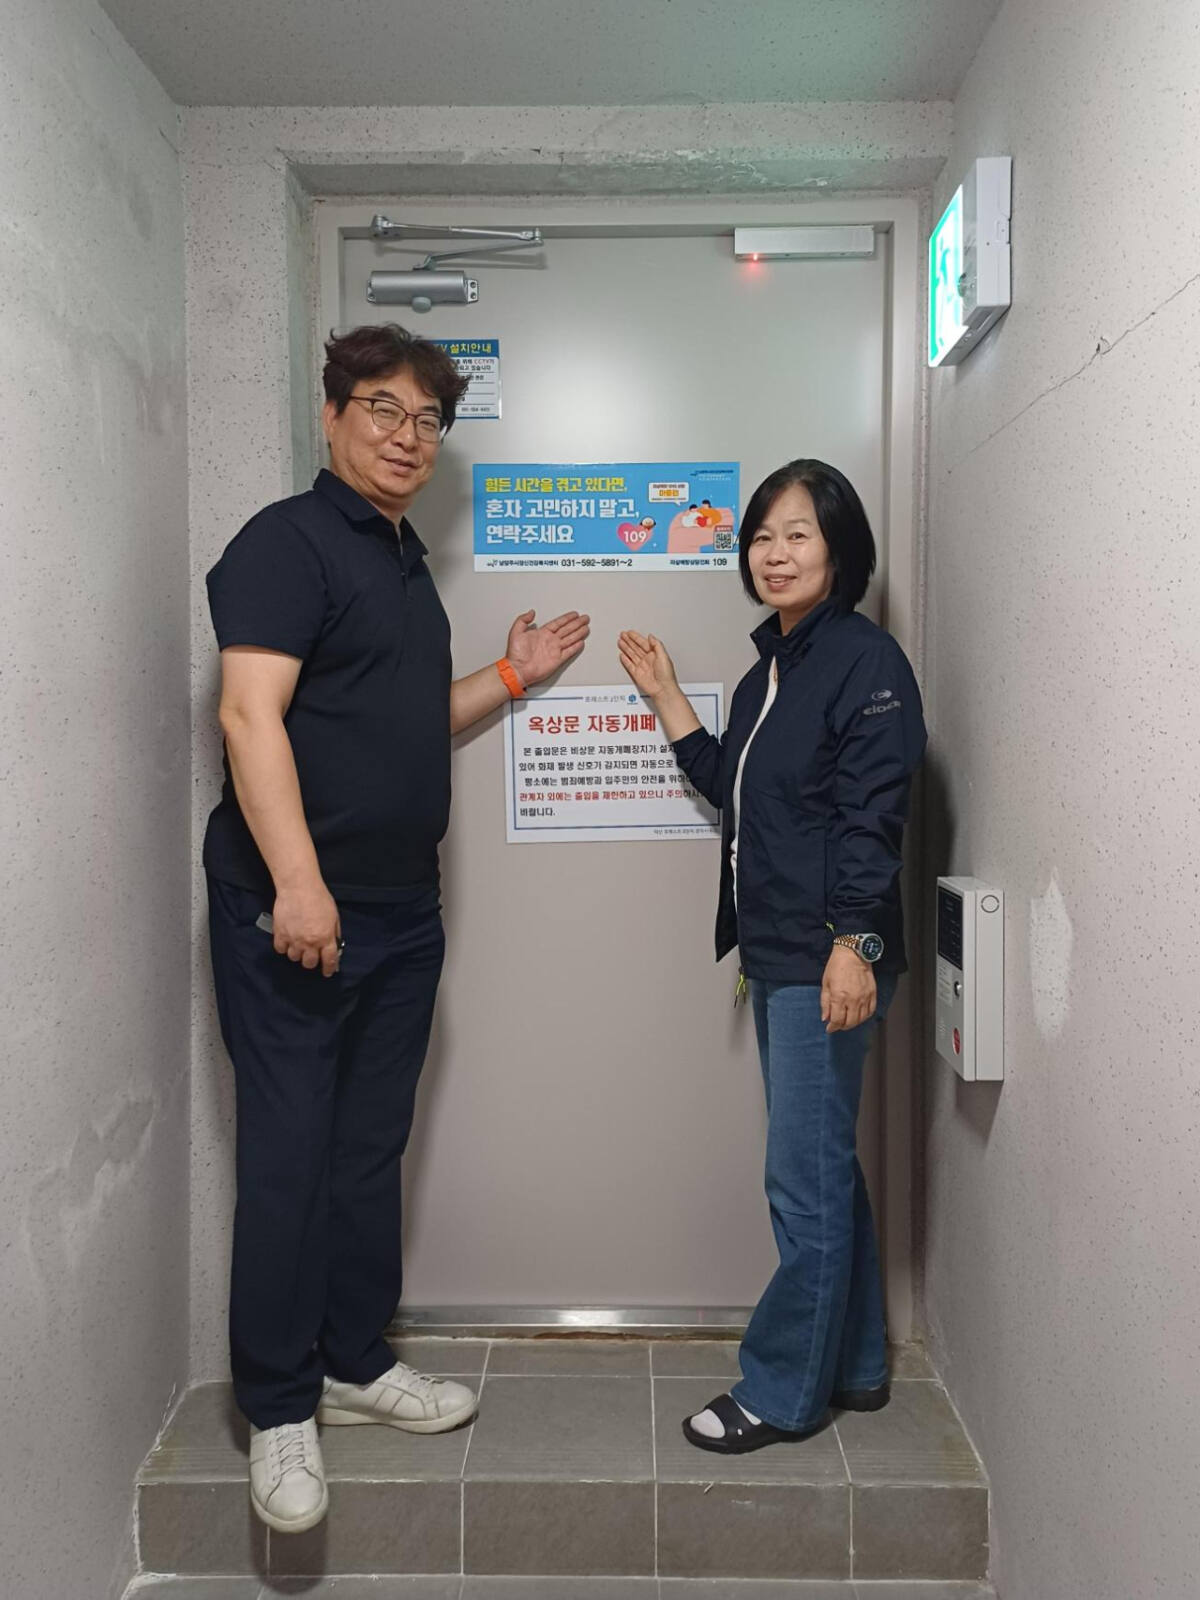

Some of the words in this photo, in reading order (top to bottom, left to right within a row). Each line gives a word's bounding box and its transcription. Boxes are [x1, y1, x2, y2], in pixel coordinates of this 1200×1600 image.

[450, 344, 492, 353] 설치안내
[485, 477, 511, 493] 힘든
[514, 477, 553, 493] 시간을
[556, 477, 583, 492] 겪고
[585, 476, 627, 492] 있다면,
[485, 499, 522, 518] 혼자
[525, 499, 595, 518] 고민하지
[599, 499, 639, 519] 말고,
[486, 524, 574, 544] 연락주세요
[623, 530, 647, 544] 109
[712, 557, 728, 566] 109
[528, 715, 580, 735] 옥상문
[587, 713, 657, 733] 자동개폐
[523, 747, 532, 757] 본
[534, 746, 568, 757] 출입문은
[570, 746, 595, 755] 비상문
[598, 744, 657, 755] 자동개폐장치가
[519, 762, 535, 772] 있어
[538, 761, 555, 771] 화재
[557, 761, 574, 771] 발생
[577, 761, 602, 770] 신호가
[604, 760, 638, 770] 감지되면
[641, 759, 675, 769] 자동으로
[525, 777, 558, 787] 평소에는
[561, 776, 602, 786] 범죄예방과
[605, 775, 638, 785] 입주민의
[641, 774, 665, 784] 안전을
[520, 792, 544, 802] 관계자
[547, 791, 572, 801] 외에는
[575, 791, 599, 801] 출입을
[603, 790, 636, 800] 제한하고
[639, 789, 664, 799] 있으니
[520, 807, 556, 817] 바랍니다.
